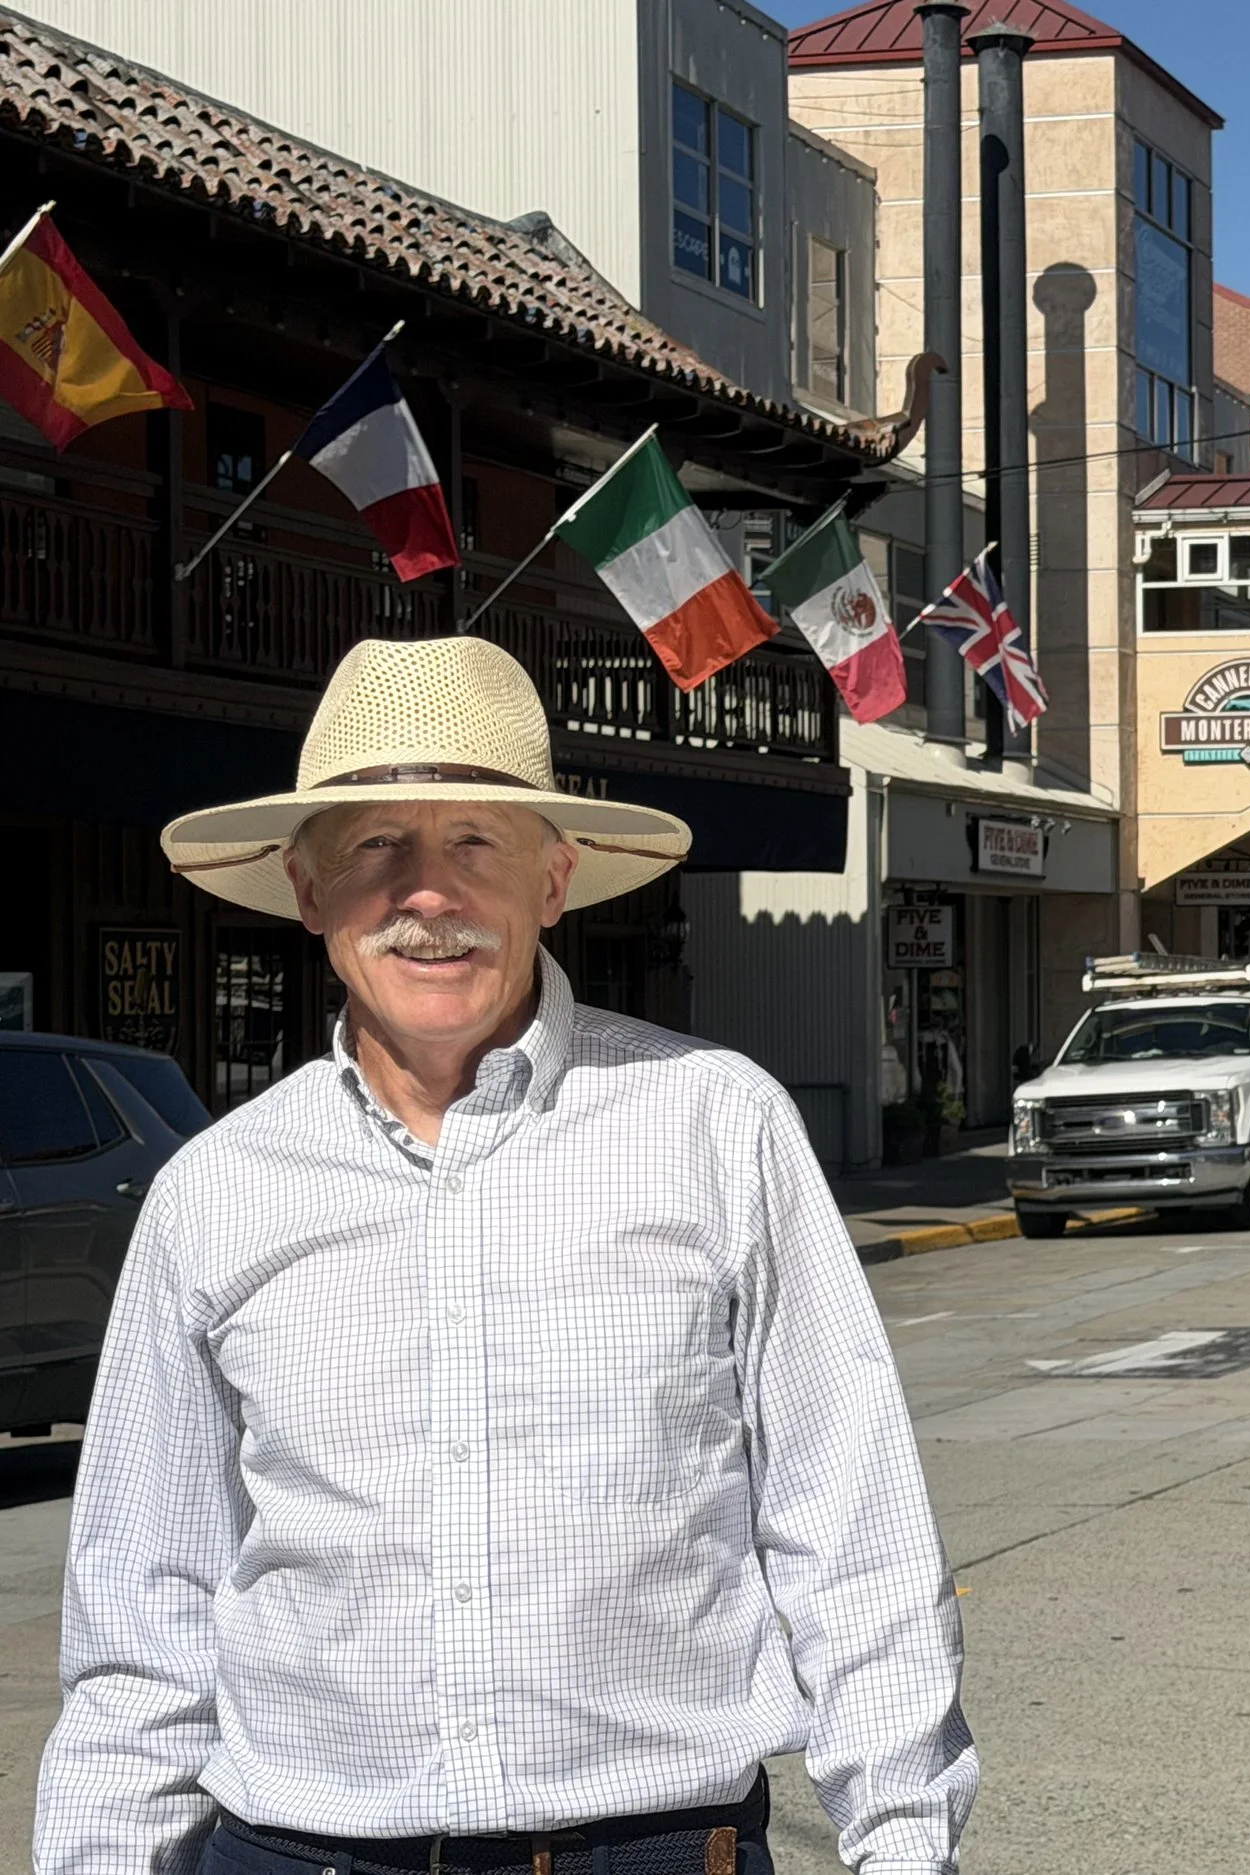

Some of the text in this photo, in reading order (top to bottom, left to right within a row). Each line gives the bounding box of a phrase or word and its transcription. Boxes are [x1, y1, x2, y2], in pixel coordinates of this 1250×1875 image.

[1179, 878, 1209, 890] FIVE
[896, 908, 942, 925] FIVE
[914, 926, 928, 941] &
[895, 942, 945, 957] DIME
[105, 941, 177, 976] SALTY
[107, 980, 176, 1016] SEAL
